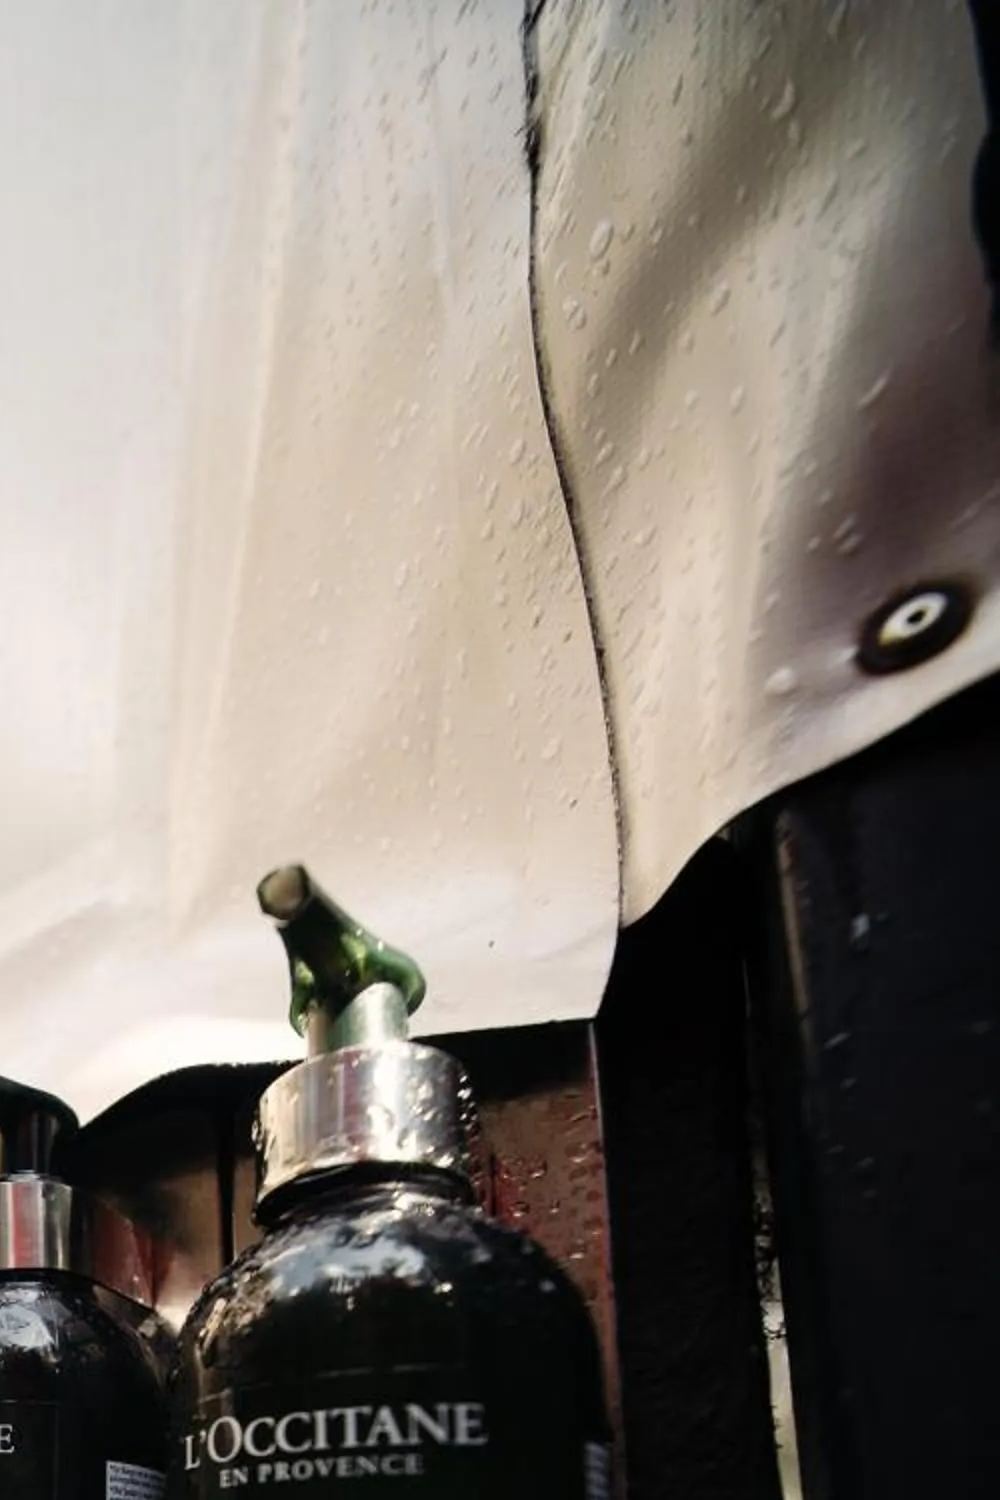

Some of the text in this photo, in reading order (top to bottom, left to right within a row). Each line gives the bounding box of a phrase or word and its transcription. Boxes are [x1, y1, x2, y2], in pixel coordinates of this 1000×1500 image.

[183, 1402, 489, 1471] L'OCCITANE
[219, 1451, 426, 1489] EN PROVENCE
